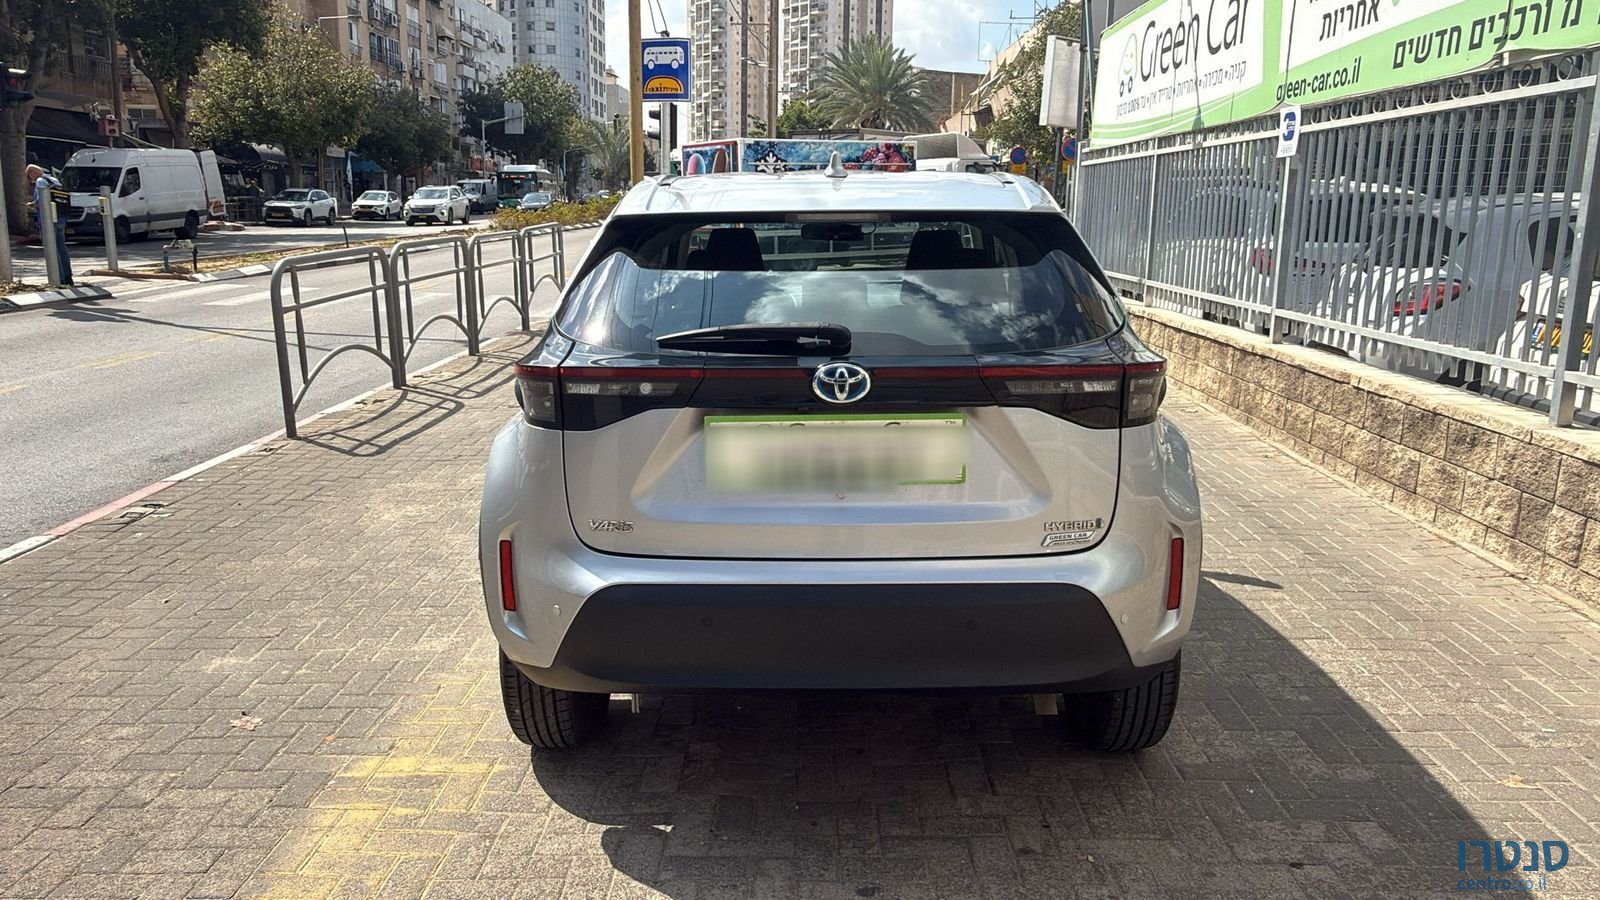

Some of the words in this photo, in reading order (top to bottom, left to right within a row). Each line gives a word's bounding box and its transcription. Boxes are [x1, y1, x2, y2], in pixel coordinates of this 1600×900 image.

[1140, 13, 1200, 82] Green
[1207, 0, 1249, 55] Car
[1319, 0, 1379, 41] אחריות
[1469, 0, 1553, 50] ורכבים
[1393, 25, 1462, 69] חדשים
[1203, 68, 1223, 88] מכירה
[1228, 61, 1247, 83] קניה
[1044, 520, 1096, 531] HYBRID
